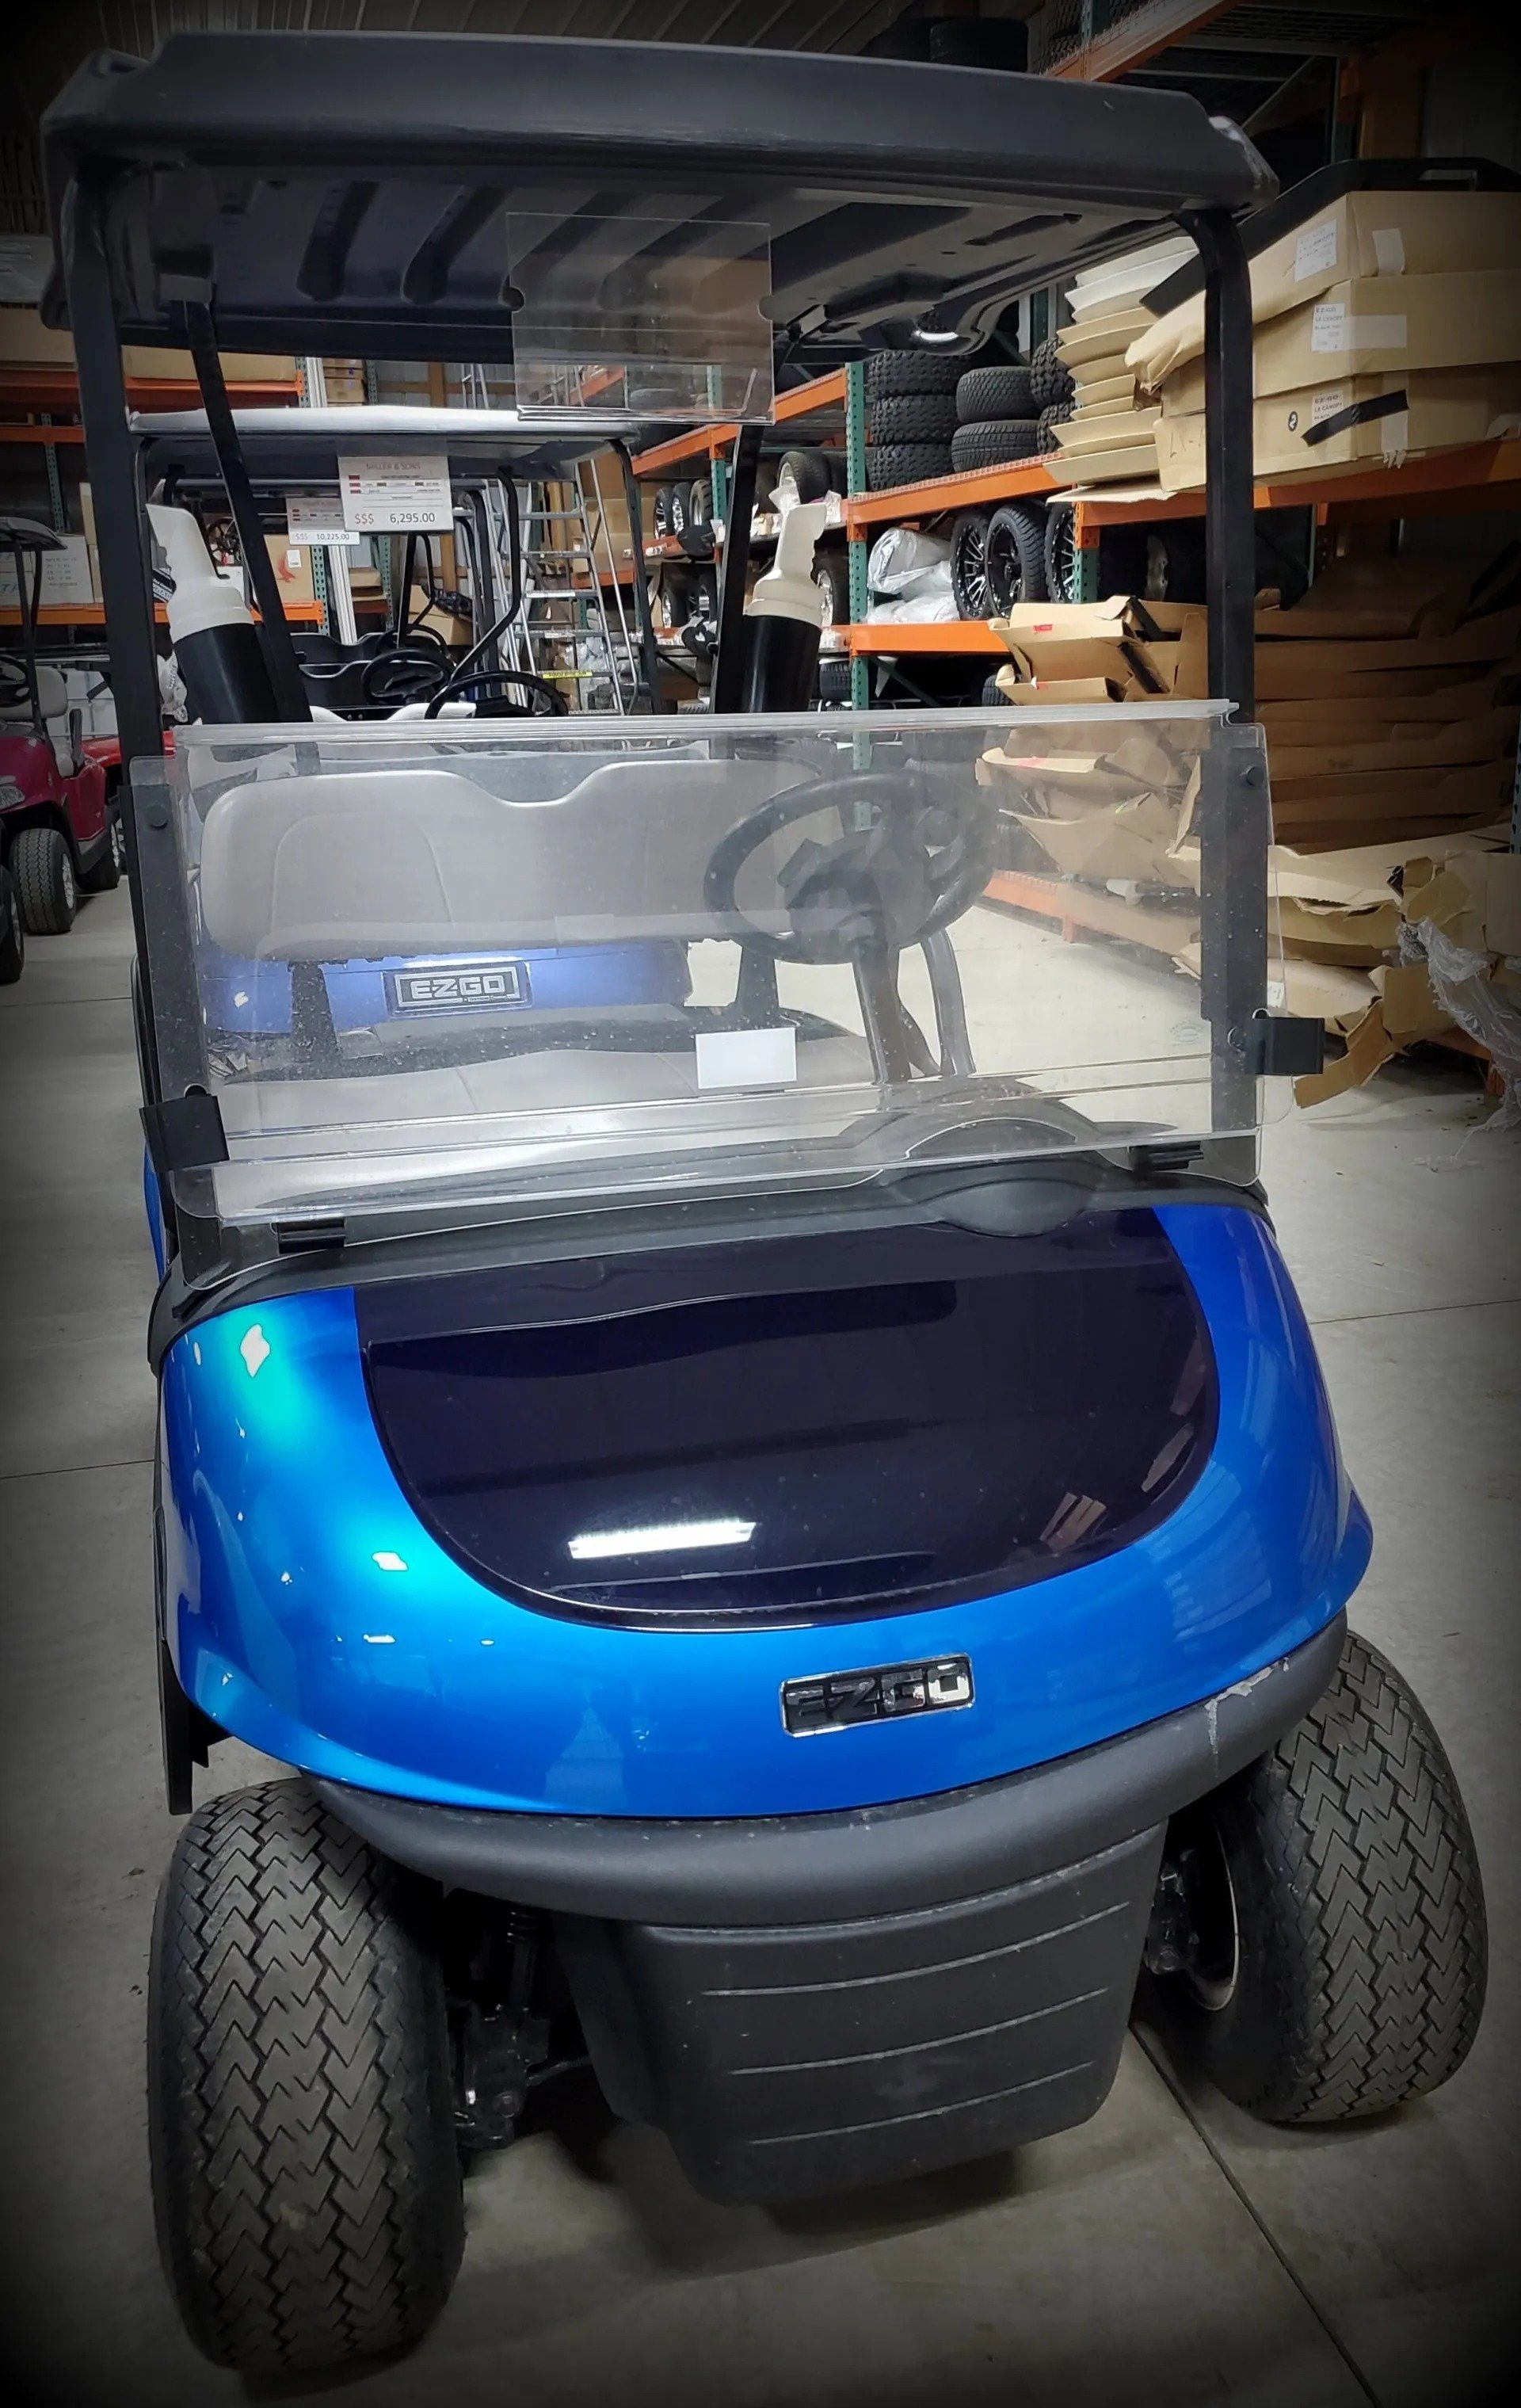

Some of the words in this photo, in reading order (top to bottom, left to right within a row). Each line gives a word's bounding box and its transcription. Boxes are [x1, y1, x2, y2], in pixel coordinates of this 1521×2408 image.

[354, 513, 375, 525] $$$
[390, 513, 436, 525] 6,295.00
[410, 975, 505, 999] EZGO
[786, 1662, 970, 1728] EZGO
